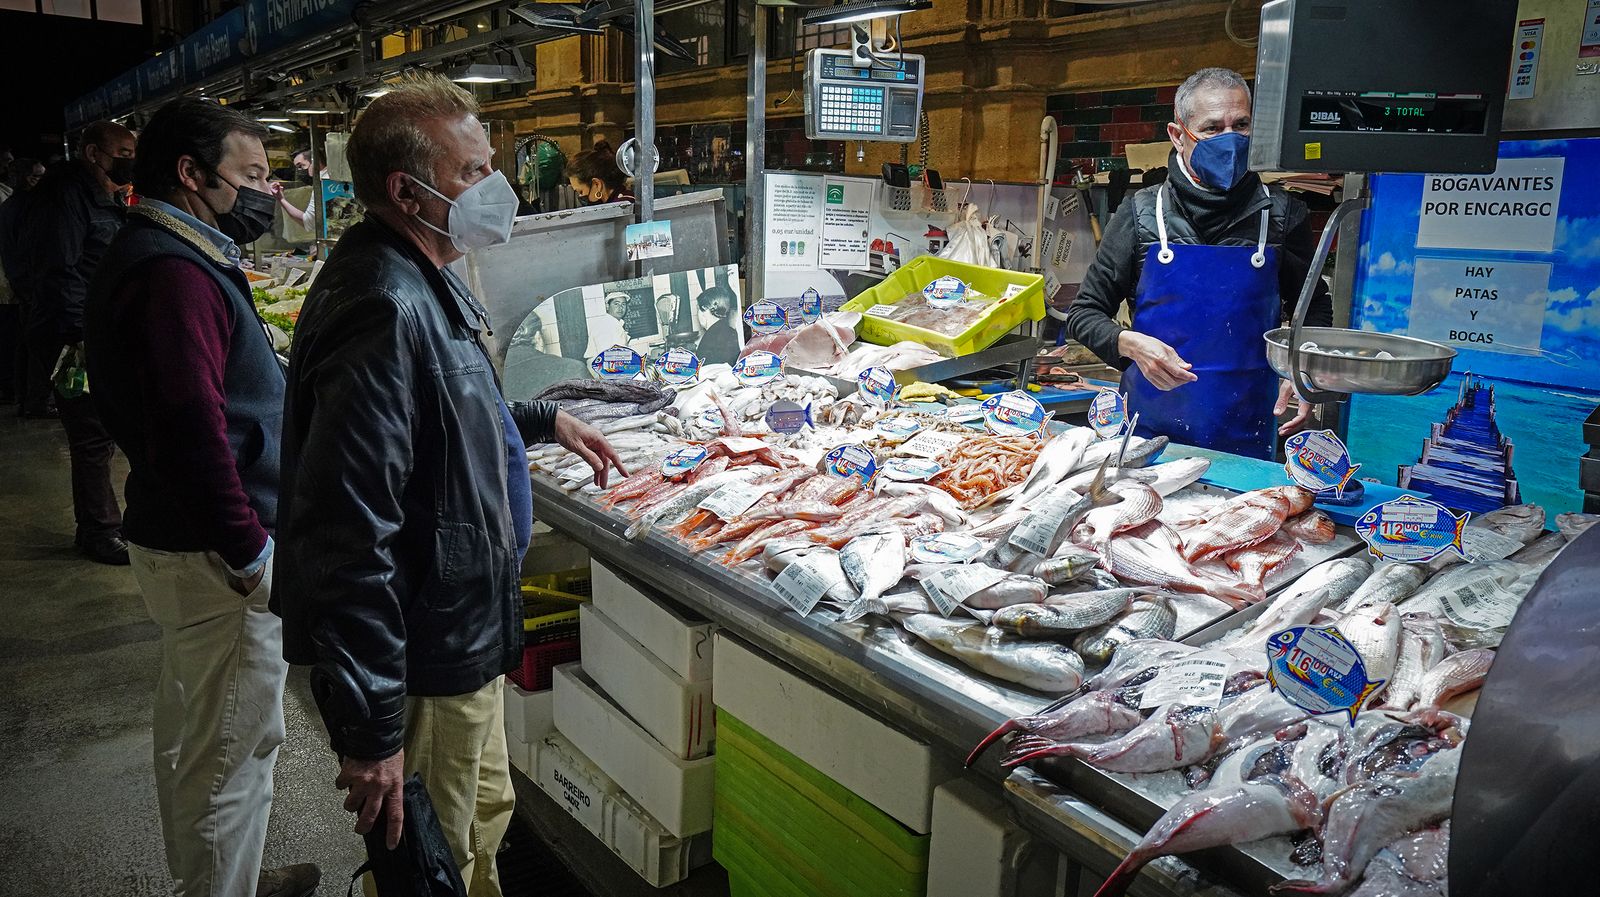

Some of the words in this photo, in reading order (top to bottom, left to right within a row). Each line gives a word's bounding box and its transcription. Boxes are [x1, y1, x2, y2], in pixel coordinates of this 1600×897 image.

[248, 3, 257, 55] 6
[1310, 112, 1341, 122] DIBAL
[1384, 107, 1390, 116] 3
[1396, 107, 1425, 117] TOTAL
[1430, 176, 1554, 192] BOGAVANTES
[1424, 202, 1460, 216] POR
[1464, 202, 1552, 217] ENCARGO
[1054, 230, 1068, 266] LANGOSTINOS
[1061, 240, 1072, 263] FRESCOS
[1464, 266, 1494, 278] HAY
[1455, 288, 1499, 300] PATAS
[1470, 310, 1478, 320] Y
[1448, 330, 1494, 344] BOCAS
[554, 769, 590, 808] BARREIRO
